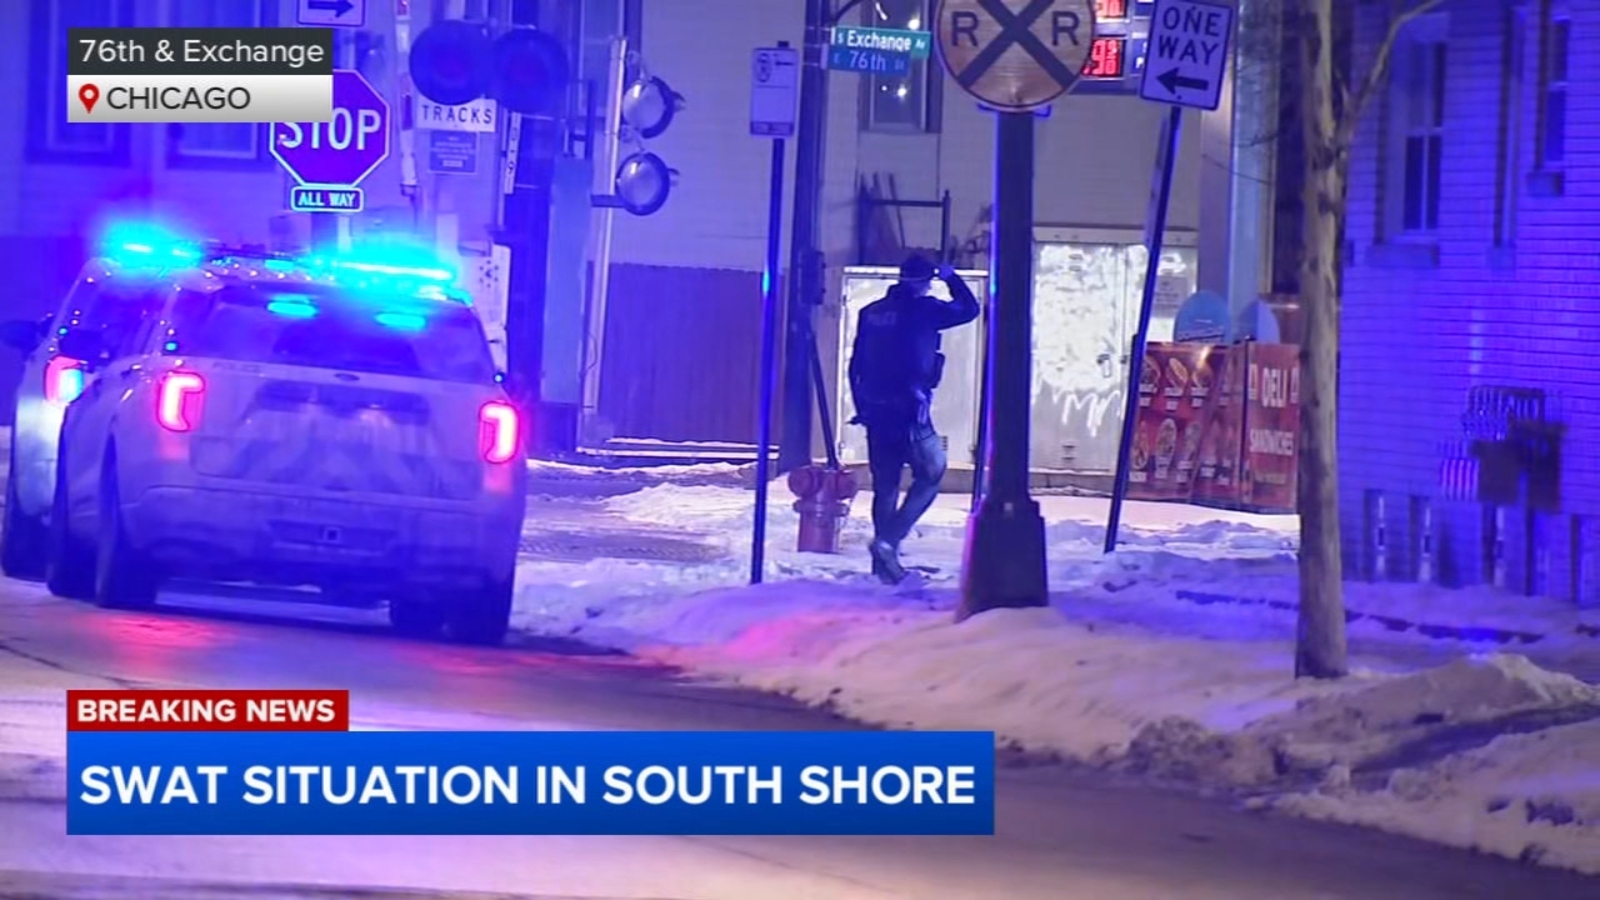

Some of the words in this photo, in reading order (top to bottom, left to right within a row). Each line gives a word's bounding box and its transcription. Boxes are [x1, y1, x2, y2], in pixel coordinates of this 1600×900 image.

[952, 11, 979, 46] R
[1052, 11, 1080, 46] R
[1163, 6, 1221, 37] ONE
[848, 30, 911, 52] Exchange
[1158, 35, 1219, 65] WAY
[850, 51, 886, 70] 76th
[422, 105, 493, 124] TRACKS
[298, 192, 325, 206] ALL
[329, 192, 356, 207] WAY
